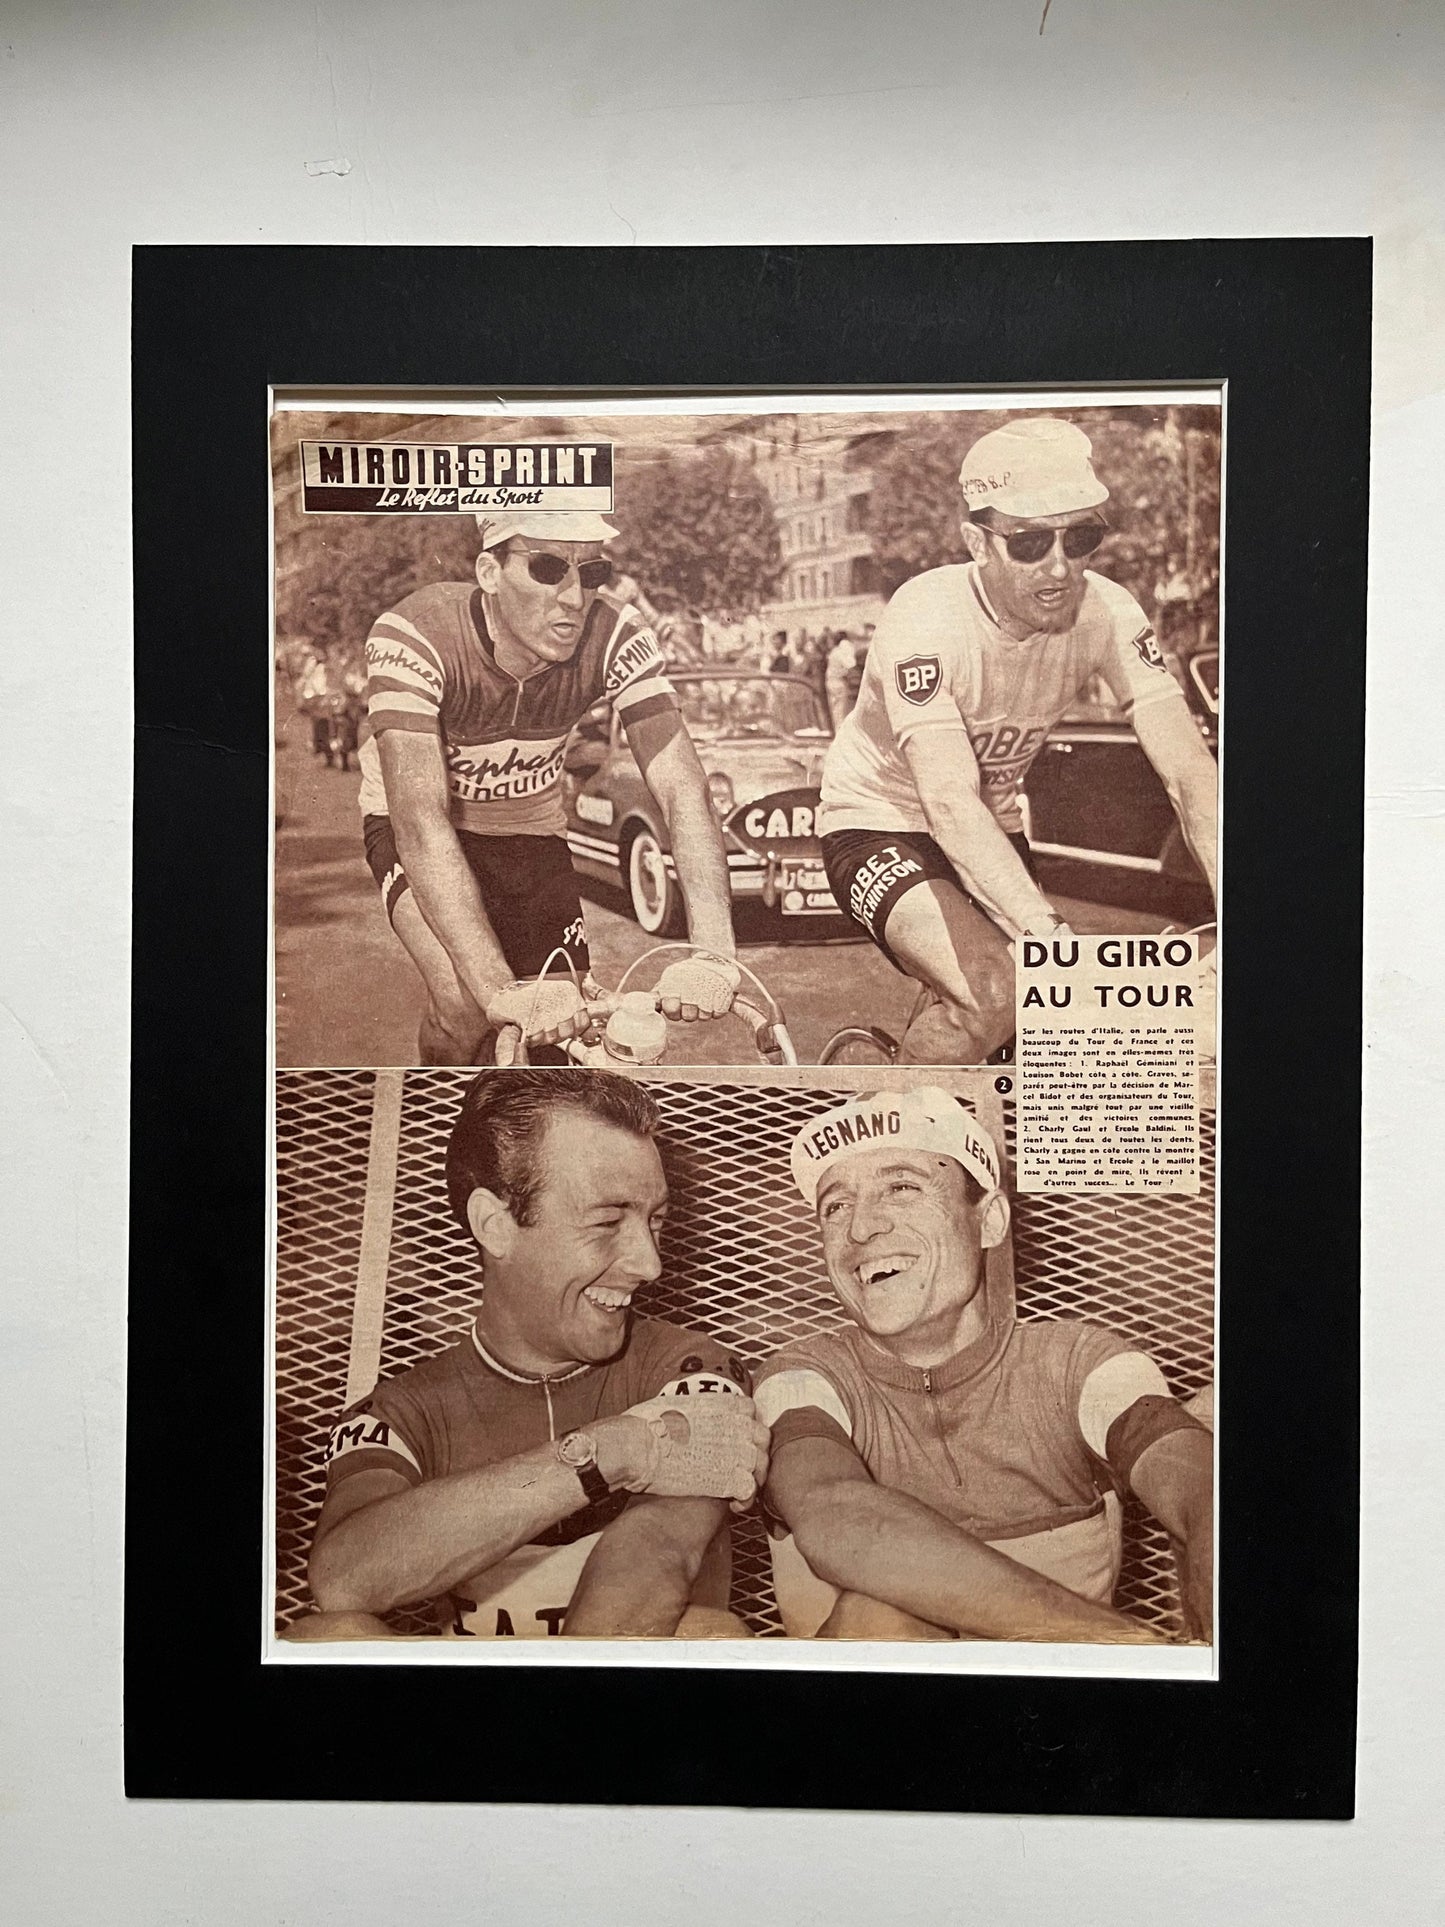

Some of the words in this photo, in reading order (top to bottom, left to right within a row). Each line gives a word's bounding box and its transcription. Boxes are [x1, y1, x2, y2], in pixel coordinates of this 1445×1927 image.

[318, 446, 598, 485] MIROIR-SPRINT
[375, 487, 400, 507] Le
[403, 487, 458, 511] Reflet
[460, 487, 490, 505] du
[491, 487, 544, 509] Sport
[900, 665, 937, 693] BP
[1022, 940, 1080, 968] DU
[1096, 938, 1194, 969] GIRO
[1022, 986, 1072, 1008] AU
[1094, 985, 1195, 1009] TOUR
[1146, 1027, 1167, 1035] parle
[1048, 1049, 1077, 1057] images
[1023, 1082, 1044, 1090] parés
[802, 1110, 901, 1162] LEGNANO
[1038, 1125, 1065, 1133] Charly
[1023, 1146, 1050, 1155] Charly
